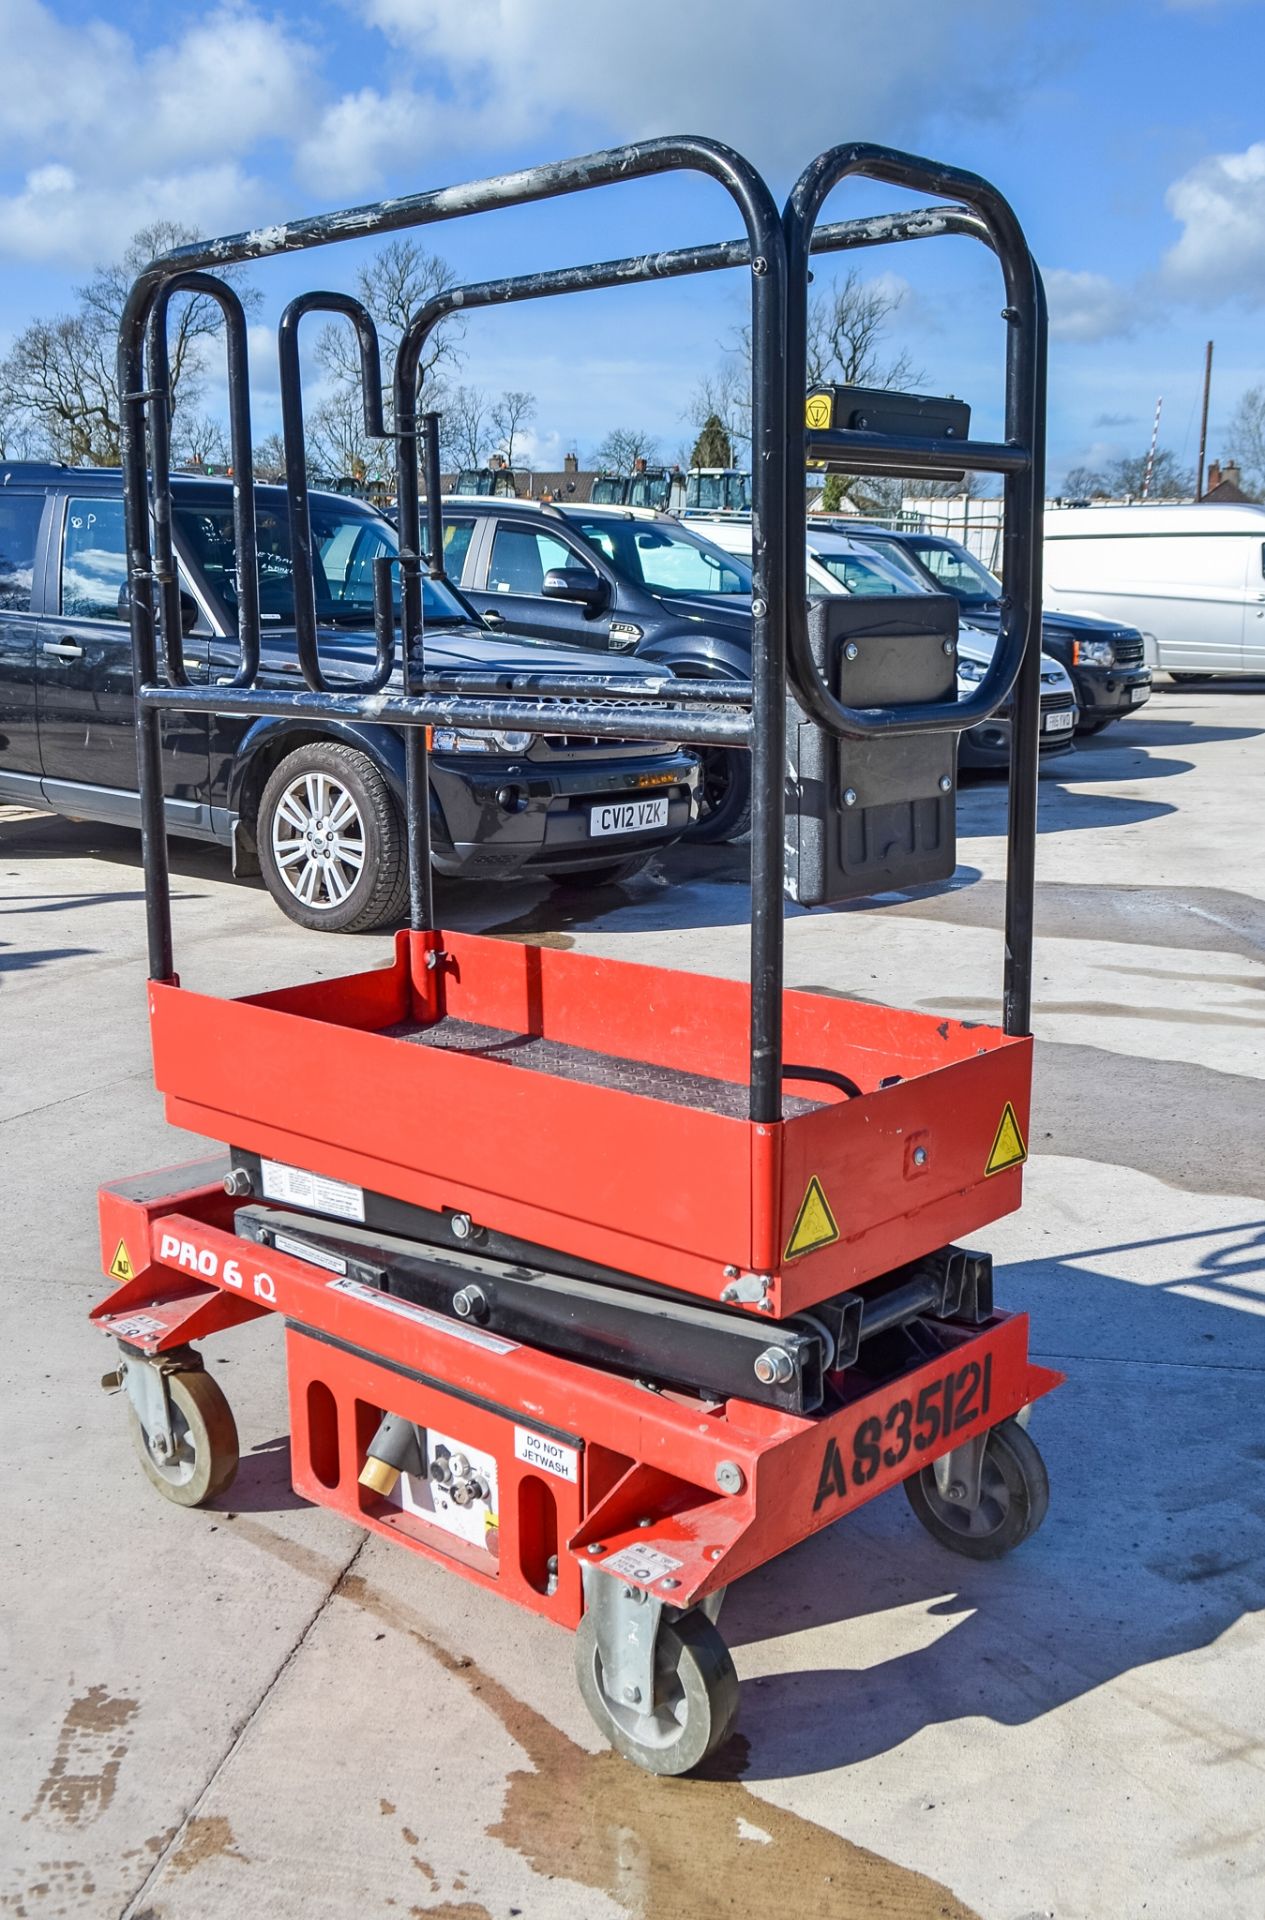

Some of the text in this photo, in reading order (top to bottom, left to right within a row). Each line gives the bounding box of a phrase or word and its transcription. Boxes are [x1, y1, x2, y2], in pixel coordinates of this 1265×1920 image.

[601, 801, 661, 830] CV12 VZK
[160, 1234, 219, 1277] PRO
[222, 1259, 244, 1289] 6
[812, 1352, 993, 1513] A835121
[526, 1435, 564, 1460] DO NOT
[522, 1449, 569, 1477] JETWASH
